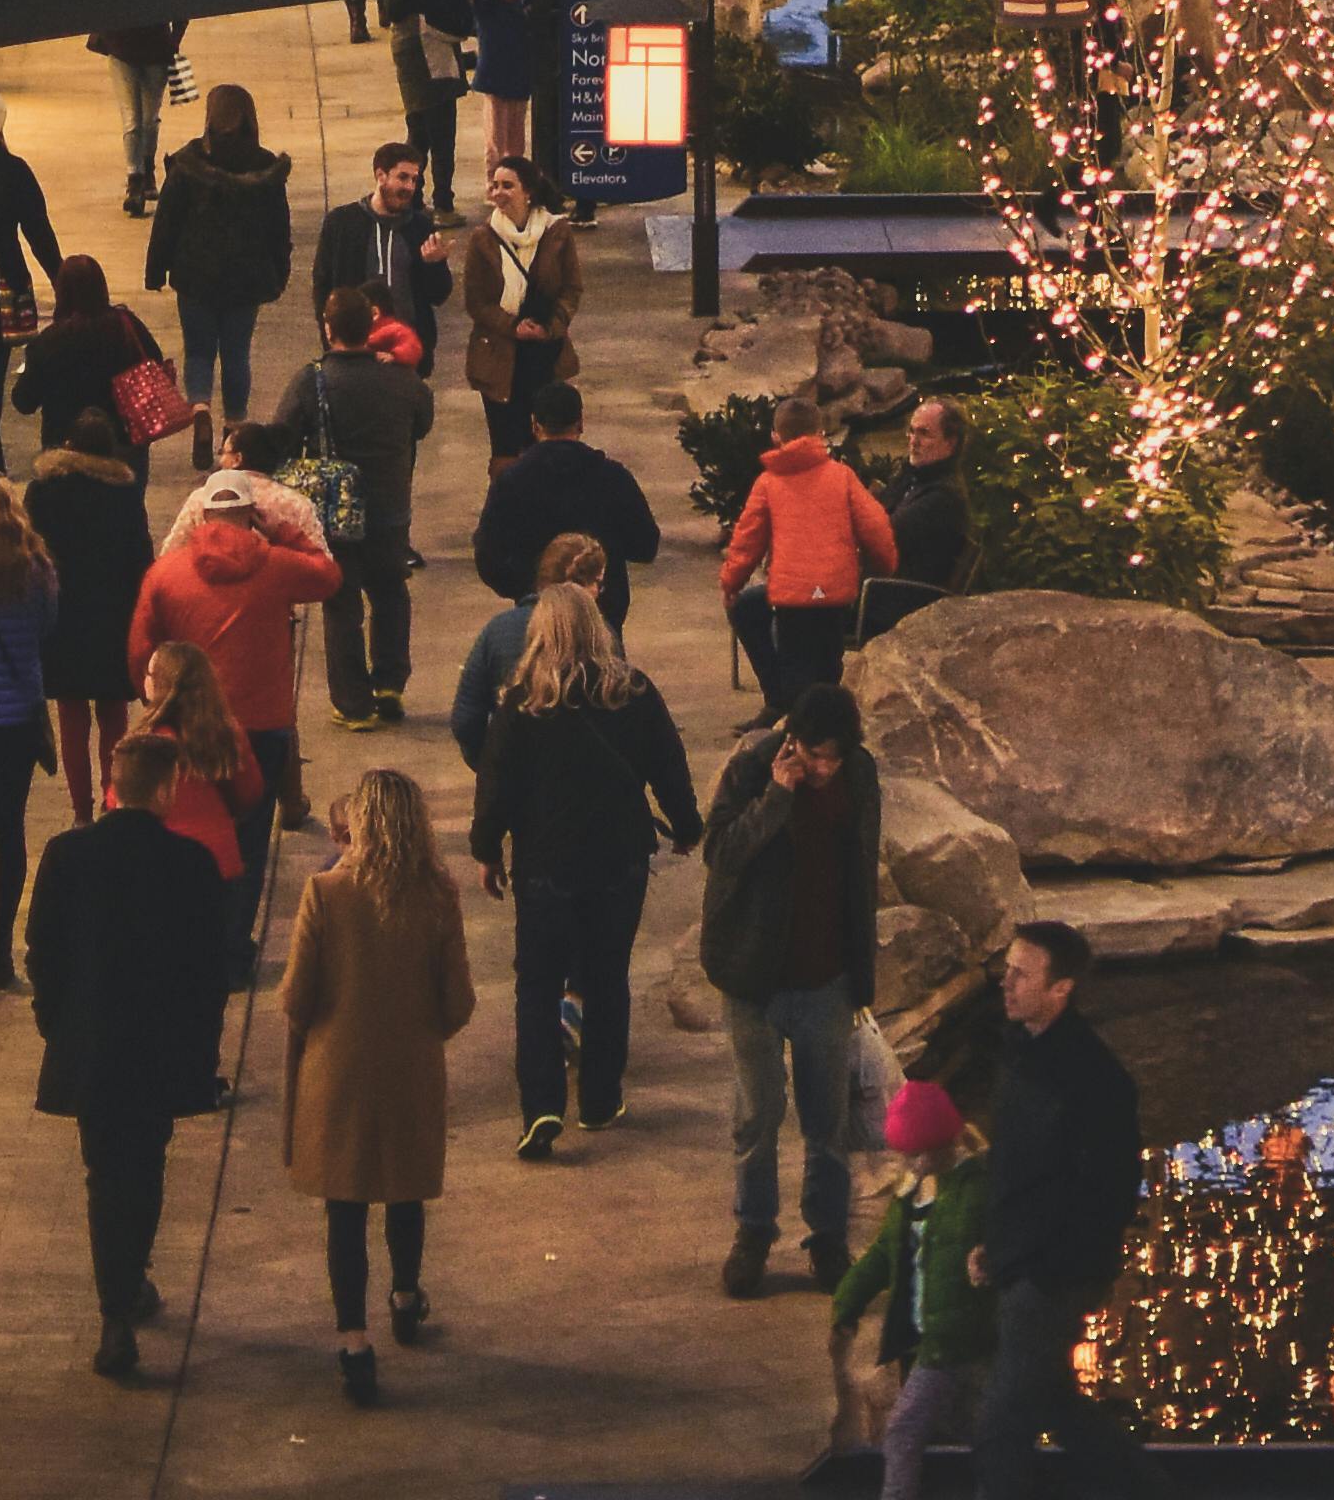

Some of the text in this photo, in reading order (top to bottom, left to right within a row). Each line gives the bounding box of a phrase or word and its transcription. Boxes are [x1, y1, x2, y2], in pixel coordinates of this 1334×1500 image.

[571, 33, 588, 45] Sky
[571, 111, 604, 123] Main
[571, 172, 627, 185] Elevators
